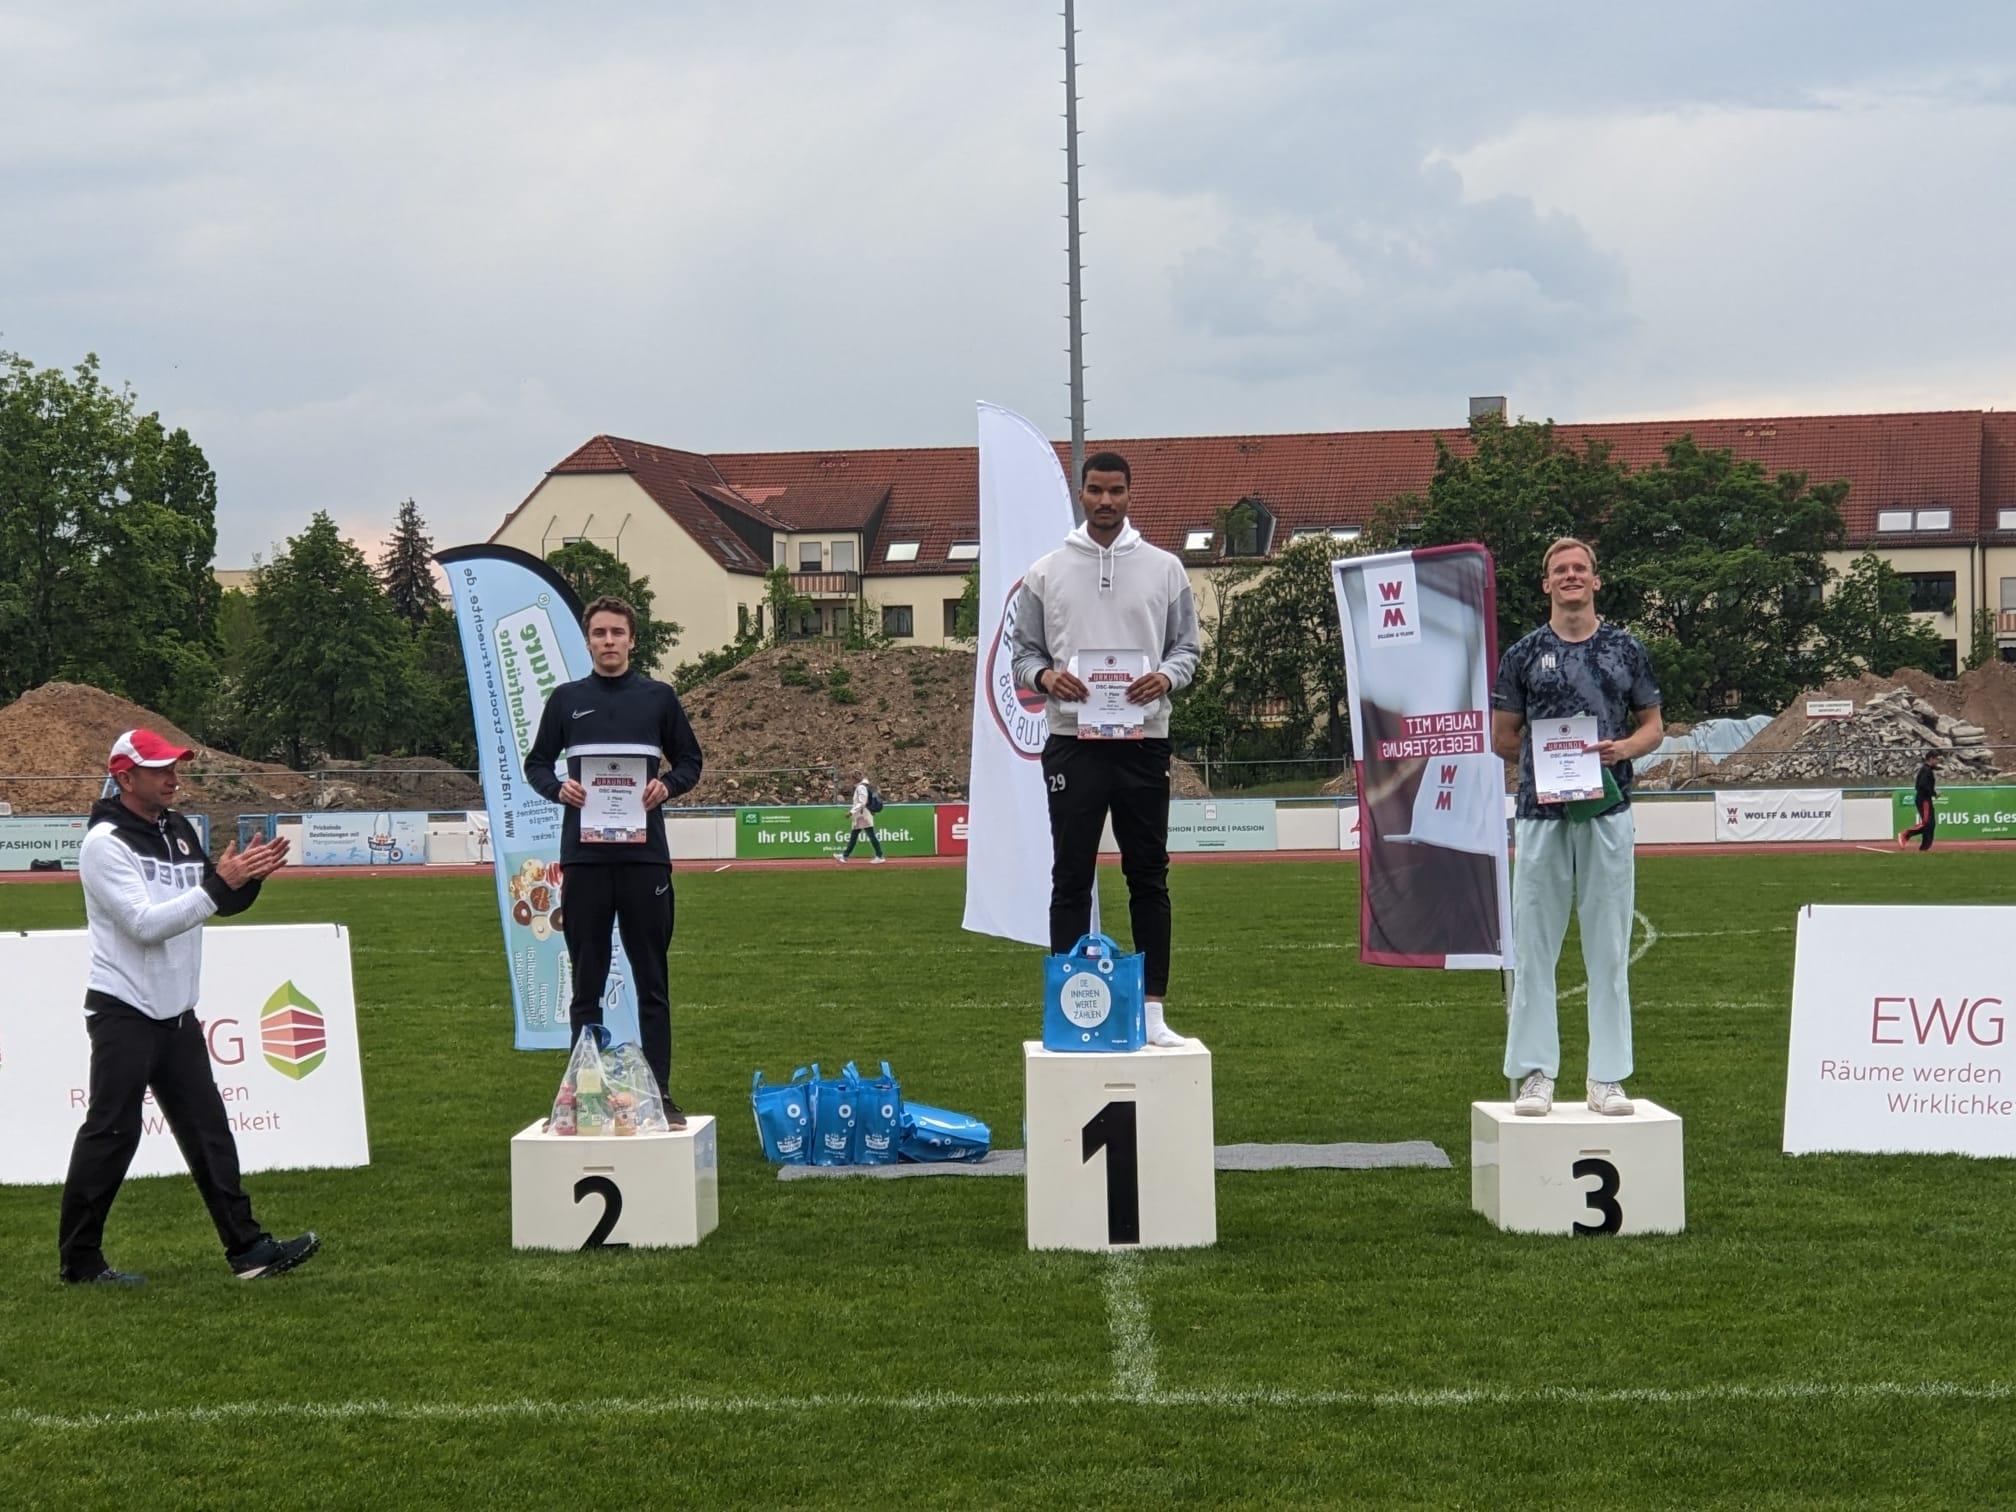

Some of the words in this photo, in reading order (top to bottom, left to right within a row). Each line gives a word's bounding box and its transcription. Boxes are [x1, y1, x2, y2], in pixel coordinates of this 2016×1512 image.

[1049, 773, 1066, 792] 29
[1744, 810, 1778, 820] WOLFF
[1780, 811, 1788, 819] &
[1790, 808, 1832, 819] MÜLLER
[1938, 812, 1969, 824] PLUS
[1973, 814, 1990, 824] an
[1994, 811, 2016, 824] Ges
[1197, 824, 1226, 833] PEOPLE
[1232, 824, 1265, 832] PASSION
[0, 840, 52, 849] FASHION
[757, 831, 776, 843] Ihr
[780, 831, 811, 843] PLUS
[814, 833, 831, 843] an
[1070, 990, 1100, 999] INNEREN
[1075, 1000, 1098, 1009] WERTE
[1872, 997, 2005, 1046] EWG
[1820, 1060, 1905, 1082] Räume
[1912, 1063, 2002, 1084] werden
[1887, 1092, 2016, 1116] Wirklichke
[1082, 1101, 1140, 1244] 1
[1572, 1158, 1623, 1237] 3
[573, 1175, 630, 1253] 2
